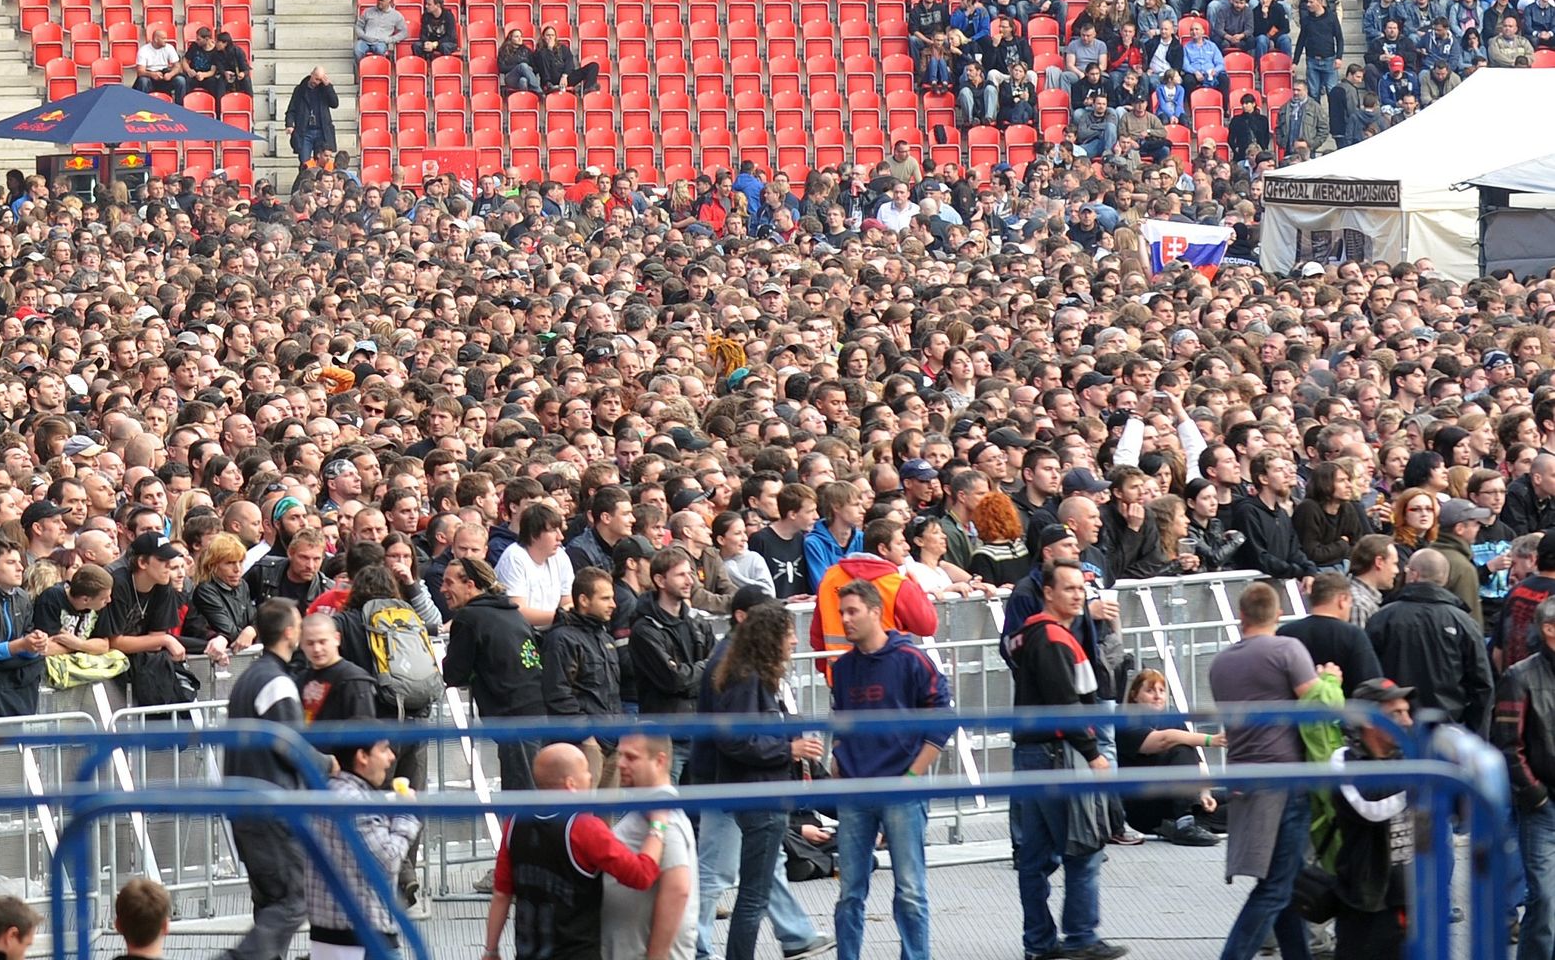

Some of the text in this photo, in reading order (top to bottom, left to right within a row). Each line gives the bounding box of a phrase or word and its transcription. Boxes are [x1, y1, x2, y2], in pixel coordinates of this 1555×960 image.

[124, 123, 189, 134] Red Bull
[1265, 180, 1397, 202] OFFICIAL MERCHANDISING
[1223, 256, 1257, 267] ECURITY
